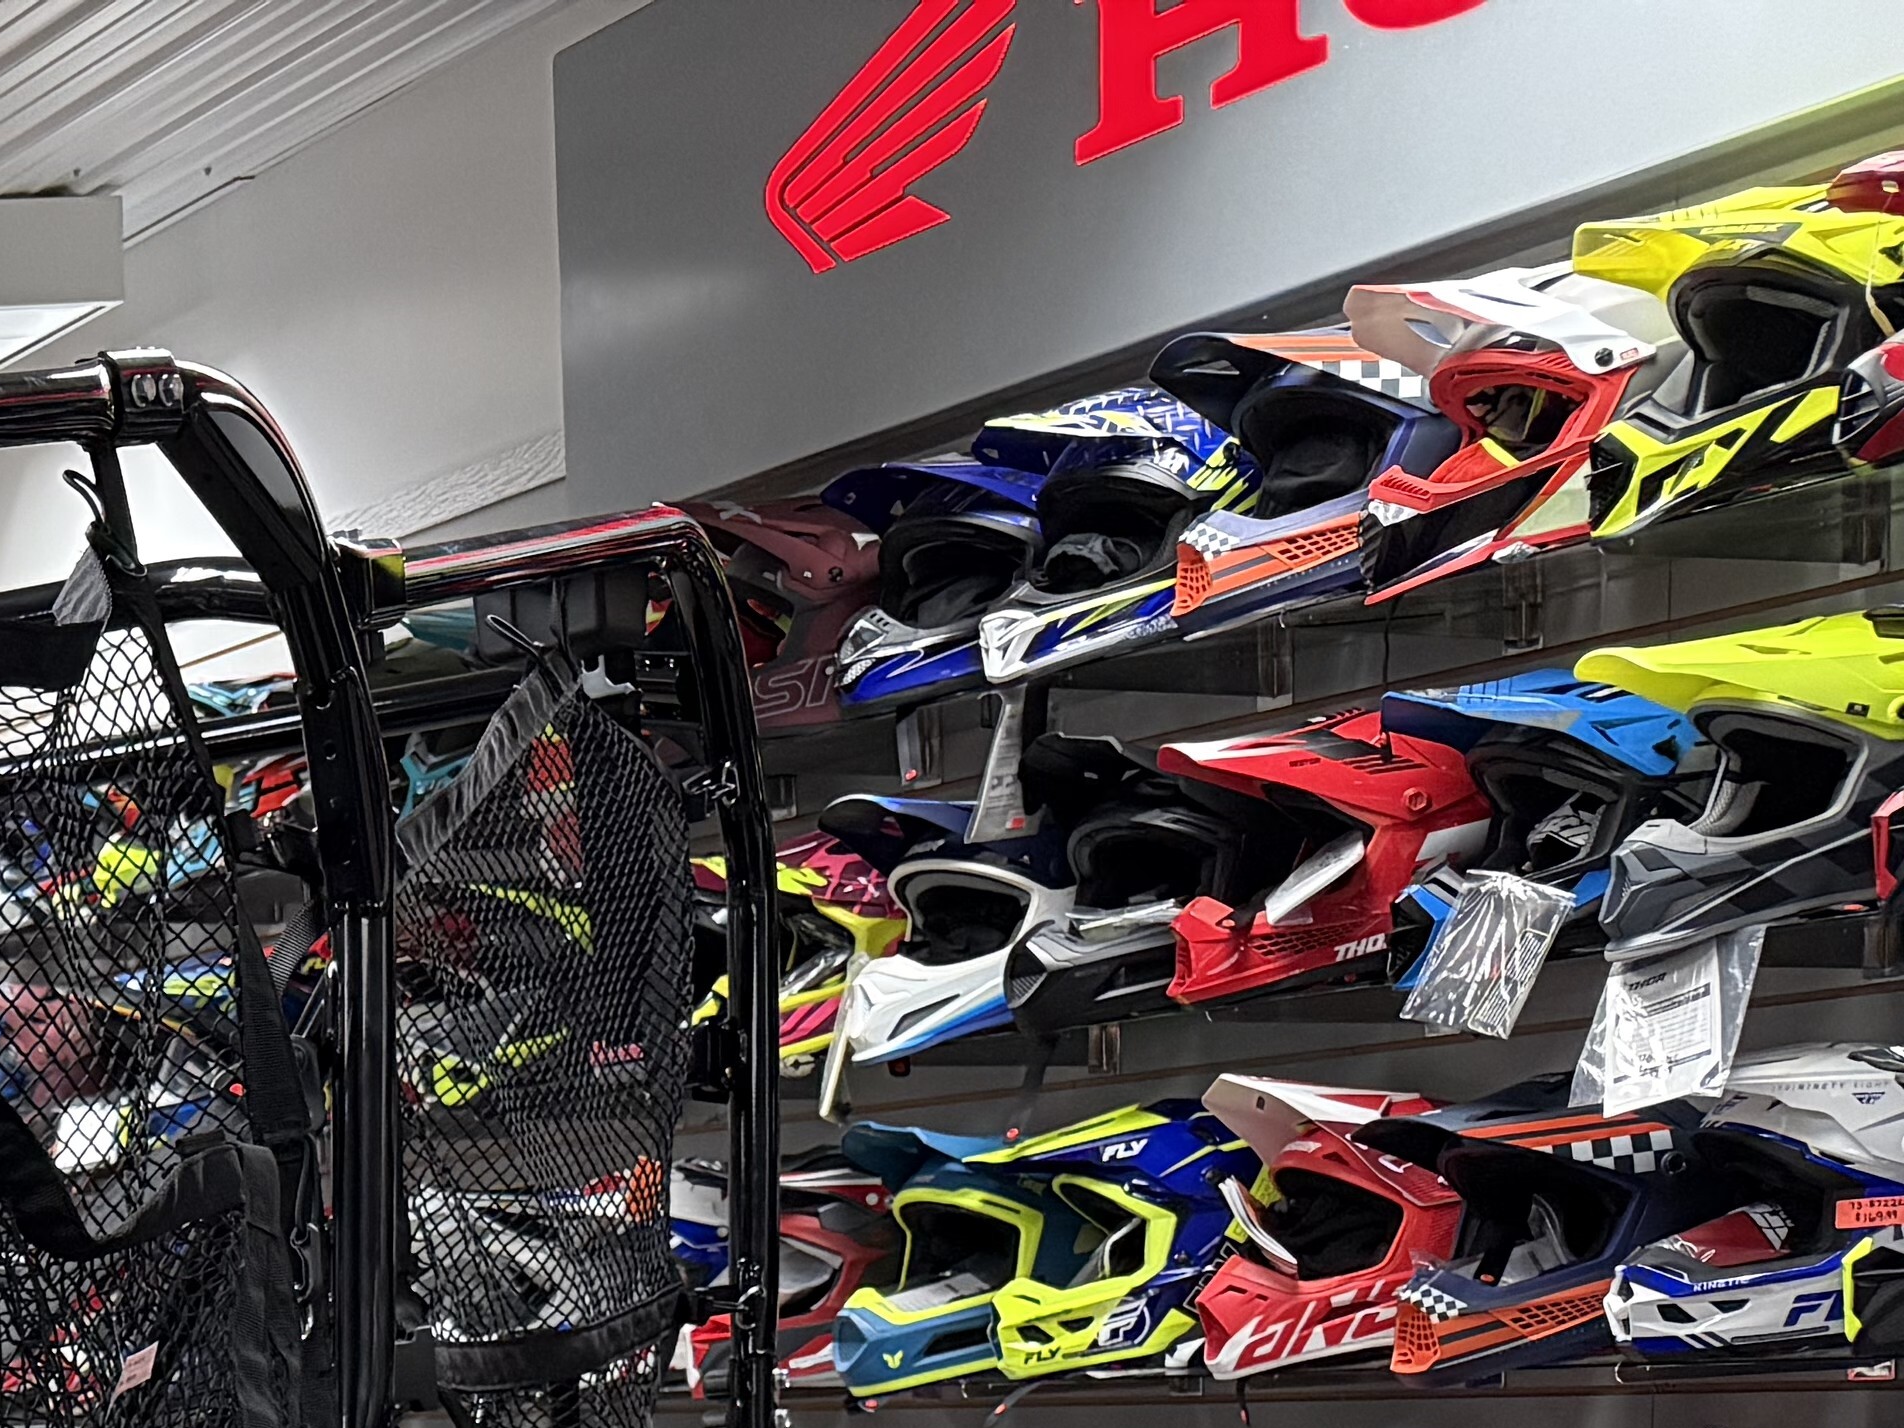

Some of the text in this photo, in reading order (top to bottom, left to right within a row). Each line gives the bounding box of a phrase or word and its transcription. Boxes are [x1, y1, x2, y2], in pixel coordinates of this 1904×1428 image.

[1102, 1138, 1149, 1162] FLY
[1692, 1277, 1752, 1292] KINETIC
[1023, 1347, 1061, 1365] FLY
